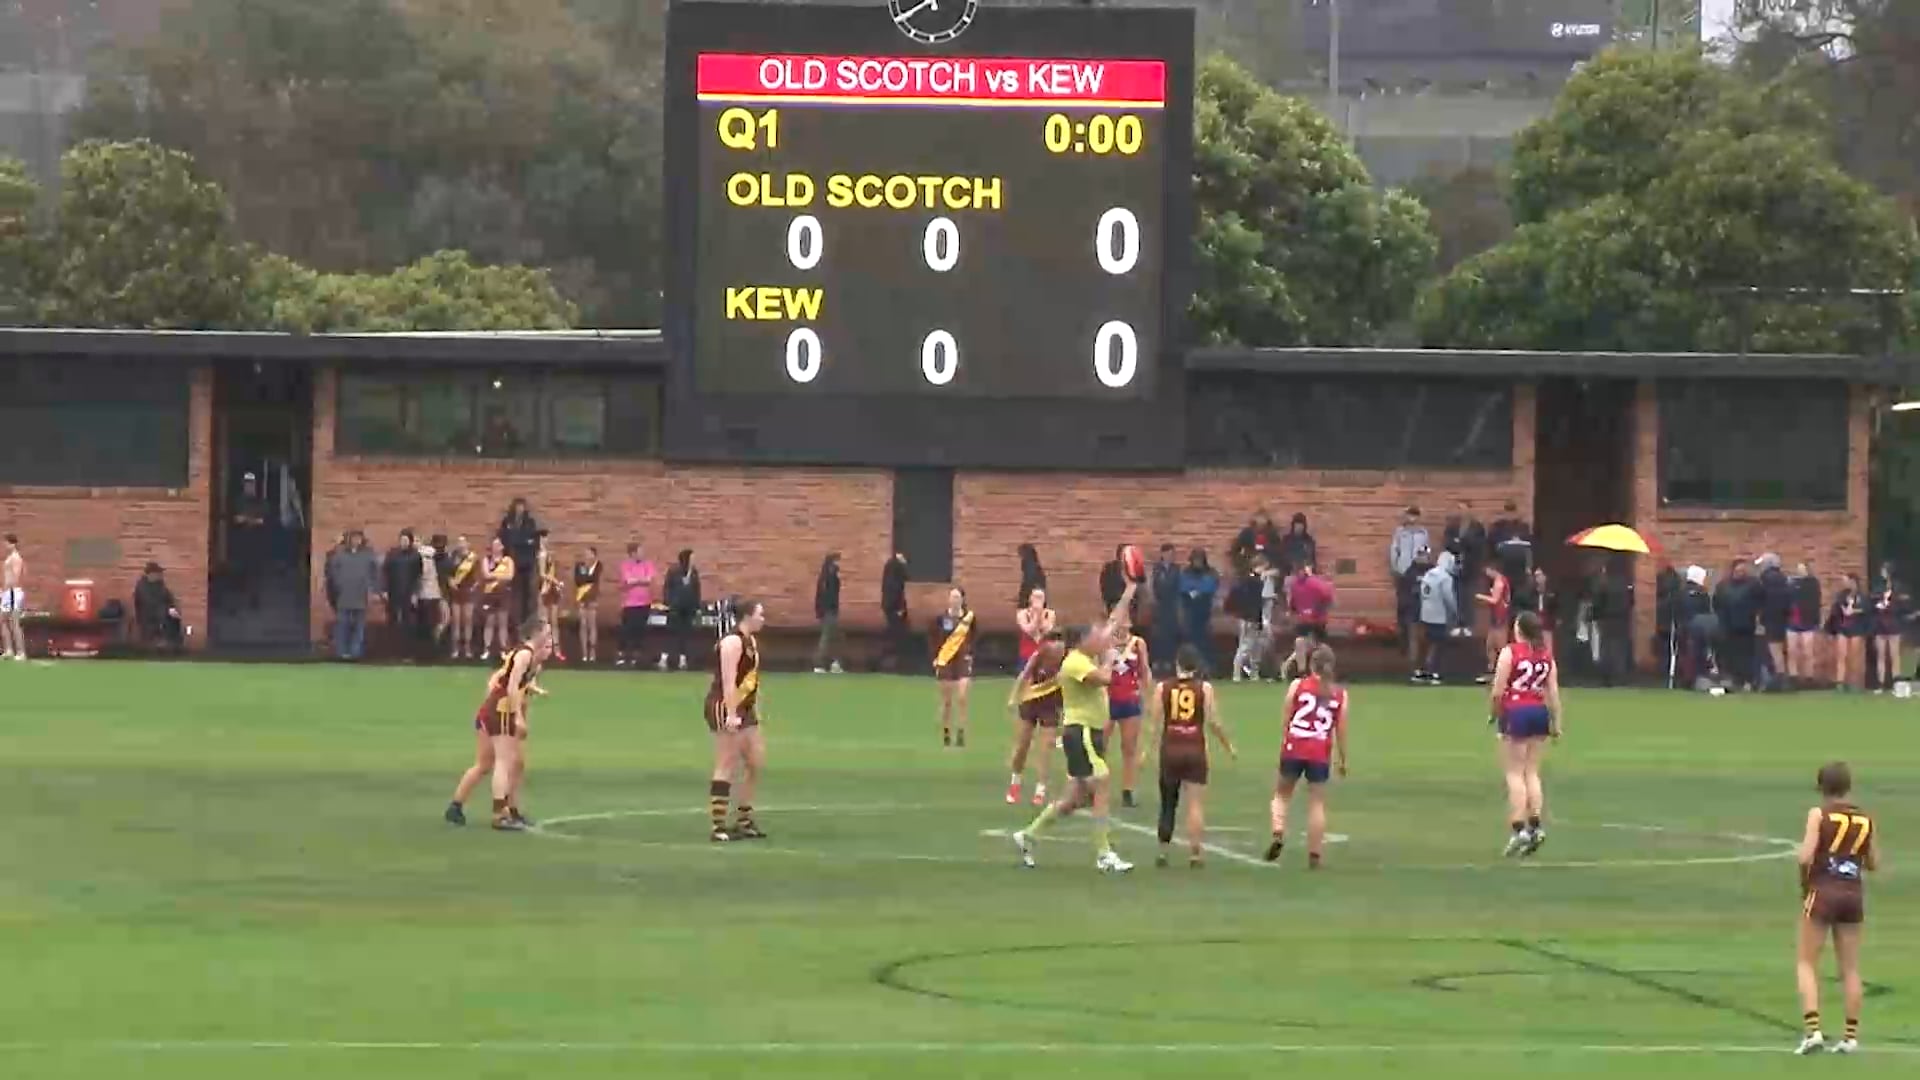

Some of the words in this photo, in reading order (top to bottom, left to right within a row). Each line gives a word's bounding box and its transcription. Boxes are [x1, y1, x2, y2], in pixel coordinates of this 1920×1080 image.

[760, 59, 826, 89] OLD
[837, 61, 975, 92] SCOTCH
[986, 70, 1019, 92] vs
[1029, 64, 1104, 94] KEW
[719, 108, 777, 150] Q1
[1044, 114, 1142, 154] 0:00
[727, 173, 814, 206] OLD
[827, 175, 1002, 209] SCOTCH
[786, 215, 823, 269] 0
[923, 217, 960, 271] 0
[1096, 207, 1140, 275] 0
[726, 287, 823, 320] KEW
[785, 328, 822, 382] 0
[921, 330, 958, 385] 0
[1094, 320, 1138, 387] 0
[1512, 659, 1550, 692] 22
[1170, 688, 1195, 720] 19
[1828, 812, 1869, 855] 77
